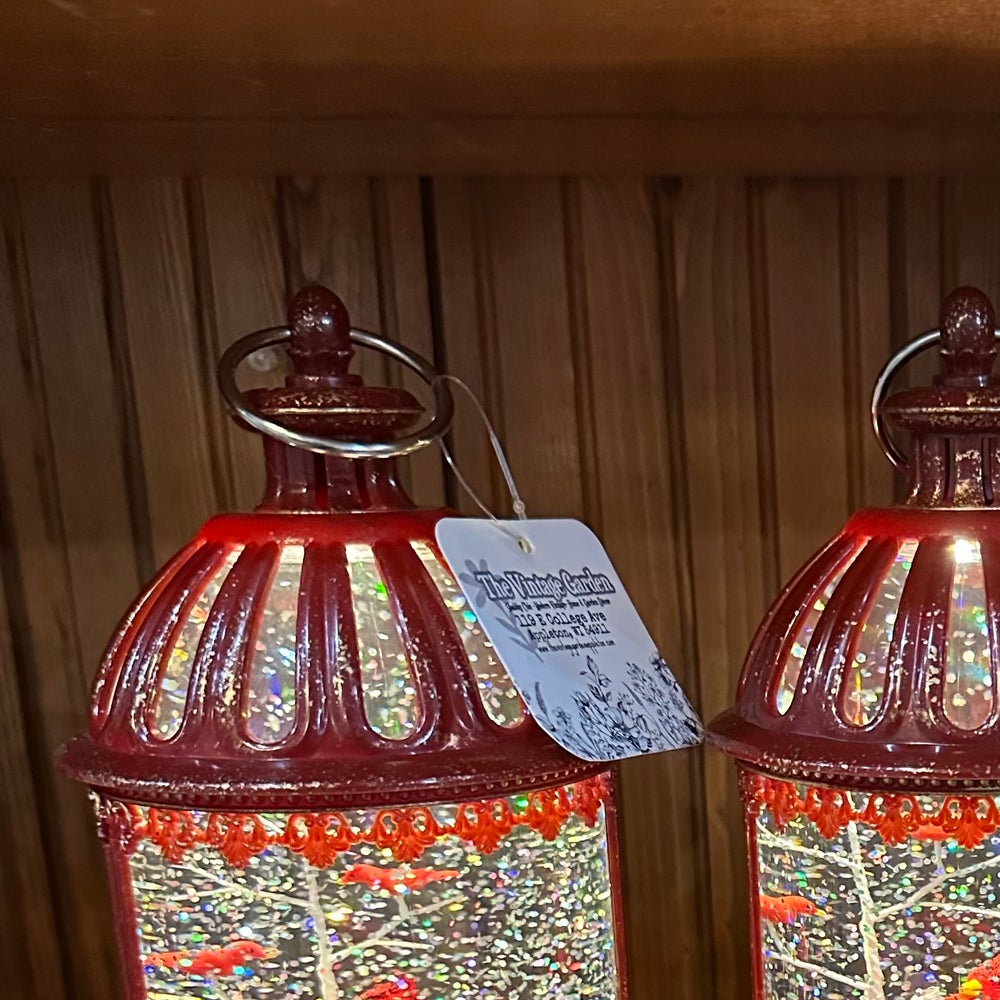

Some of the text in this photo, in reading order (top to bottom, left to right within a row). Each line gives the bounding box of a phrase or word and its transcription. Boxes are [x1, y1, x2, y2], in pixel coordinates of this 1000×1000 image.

[474, 567, 616, 601] The Vintage Garden
[515, 610, 607, 627] 119 E College Ave
[528, 623, 610, 642] Appleton, WI 54911
